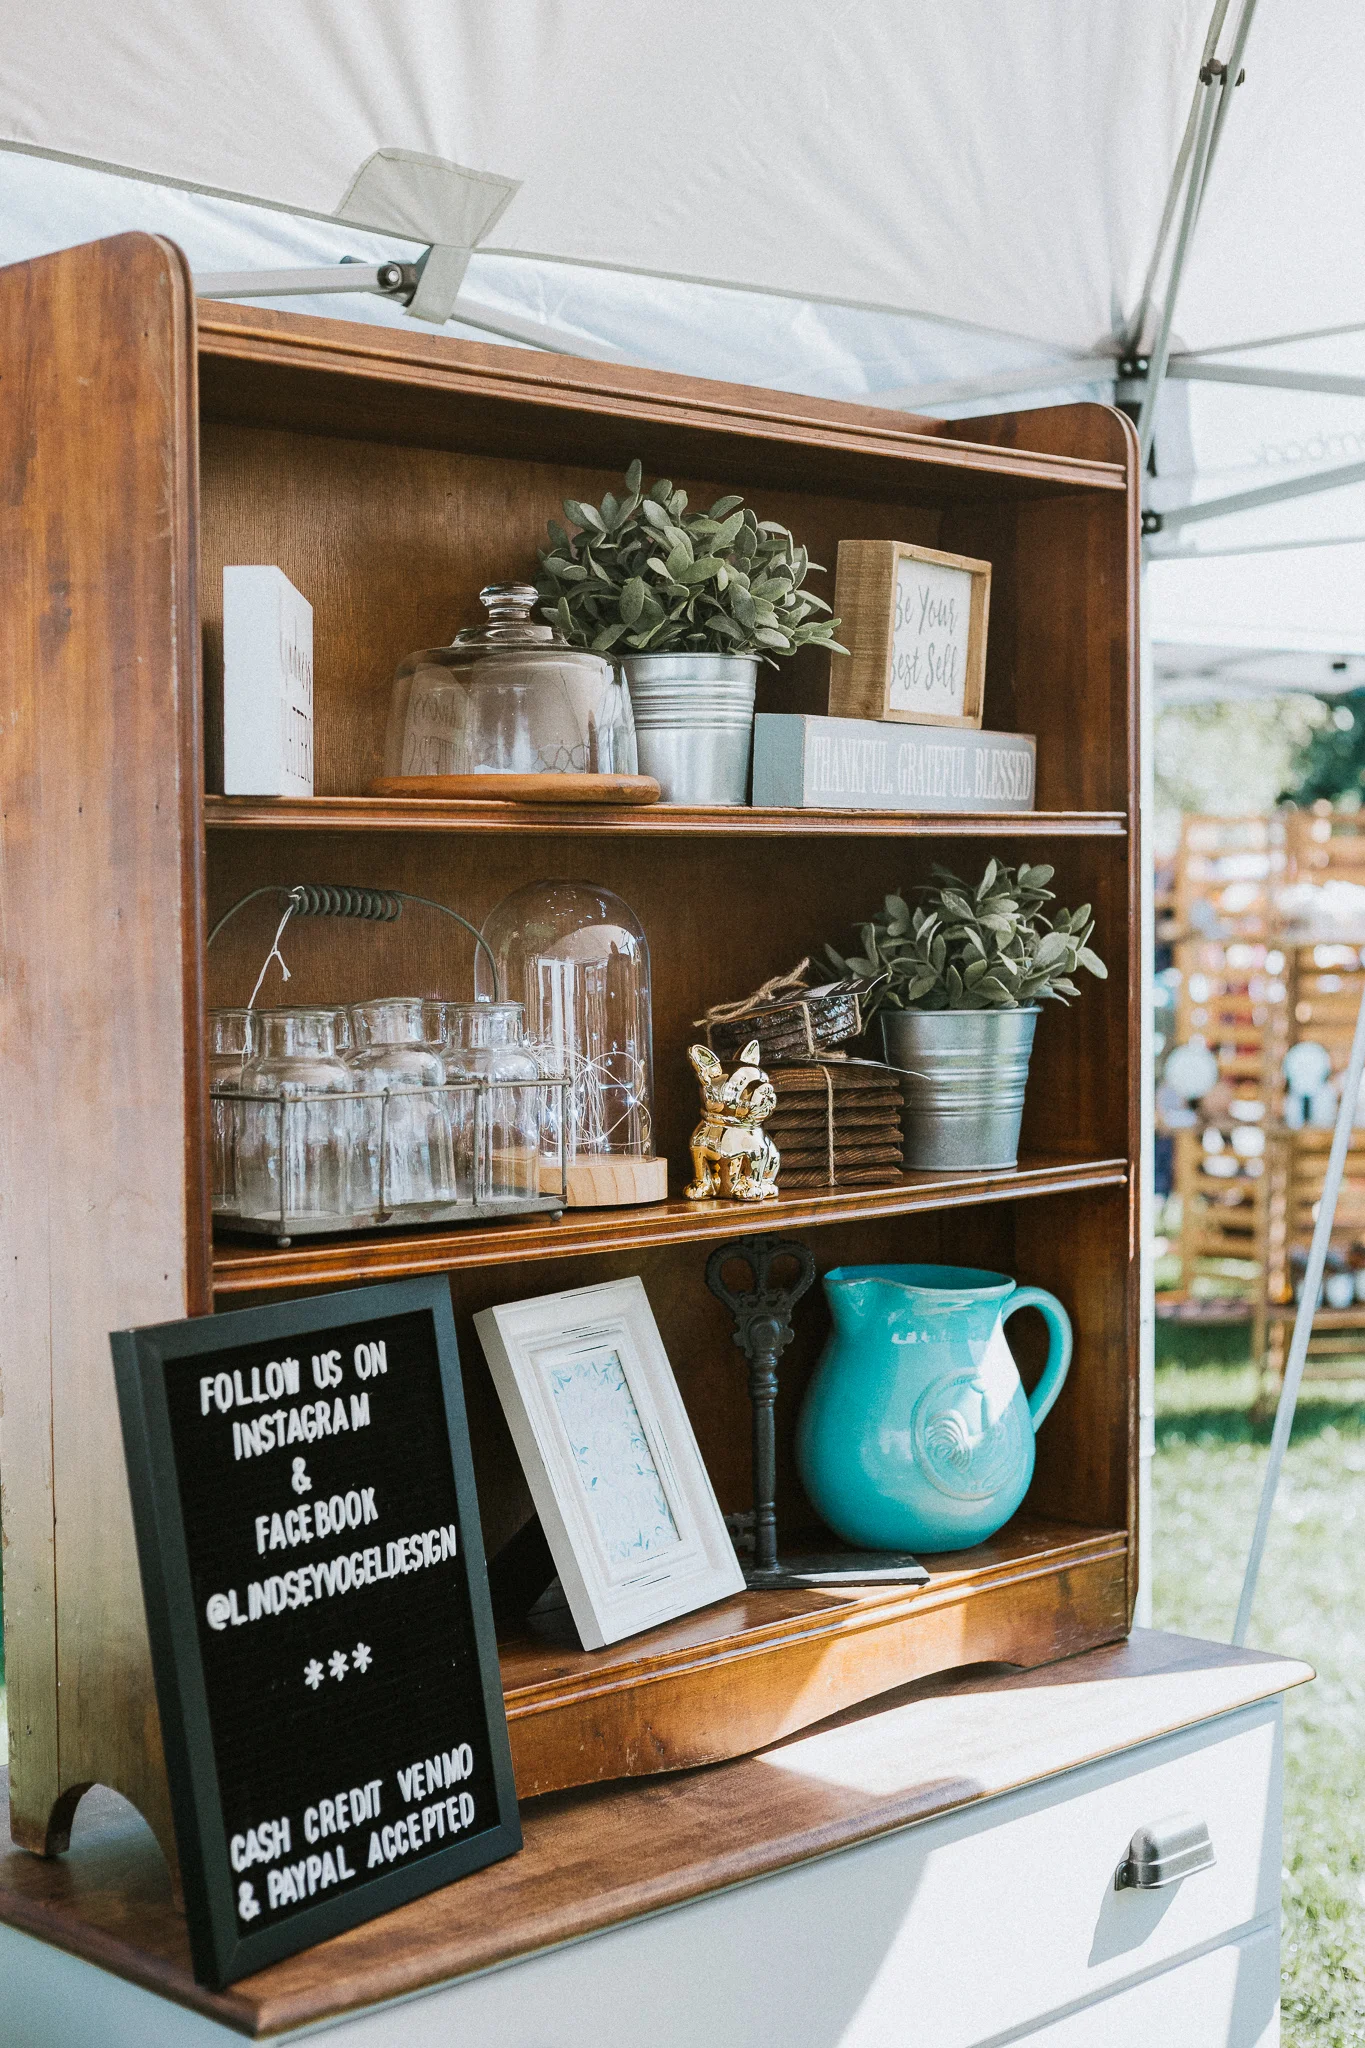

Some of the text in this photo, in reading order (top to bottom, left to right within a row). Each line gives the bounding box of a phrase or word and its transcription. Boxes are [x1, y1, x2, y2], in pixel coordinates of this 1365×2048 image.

[918, 584, 958, 636] Your
[925, 642, 960, 696] Self
[973, 747, 1033, 801] BLESSED
[200, 1340, 388, 1416] FOLLOW US ON
[232, 1392, 371, 1460] INSTAGRAM
[291, 1456, 313, 1495] &
[255, 1487, 379, 1555] FACEBOOK
[206, 1524, 457, 1631] @LINDSEYVOGELDESIGN
[230, 1742, 474, 1873] CASH CREDIT VENMO
[238, 1791, 475, 1922] & PAYPAL ACCEPTED
